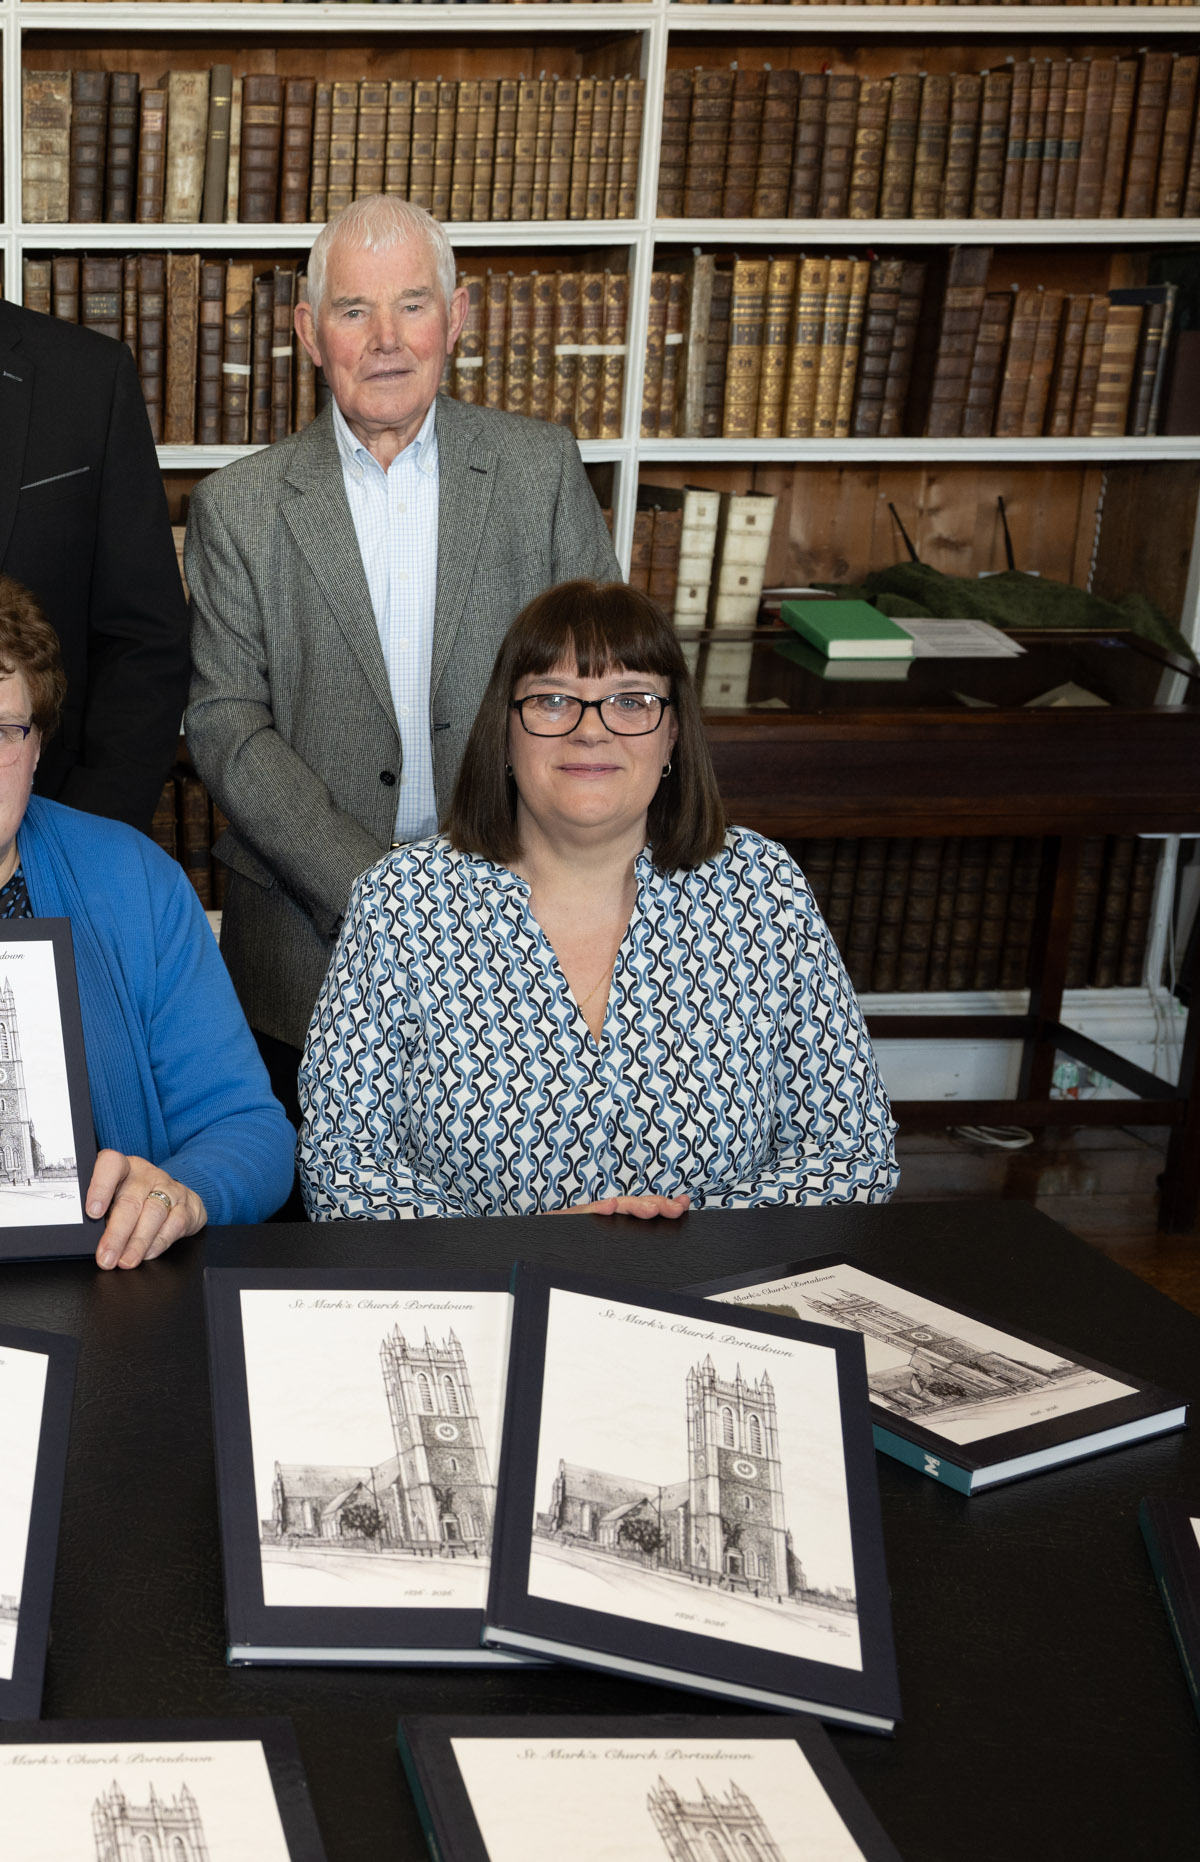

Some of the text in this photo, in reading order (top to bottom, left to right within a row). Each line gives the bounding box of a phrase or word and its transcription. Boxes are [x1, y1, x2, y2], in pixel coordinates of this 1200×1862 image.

[761, 1285, 791, 1296] Church
[791, 1274, 836, 1289] Portadown
[288, 1299, 475, 1311] St Mark's Church Portadown
[598, 1308, 795, 1358] St Mark's Church Portadown
[66, 1753, 120, 1765] Church
[517, 1748, 756, 1761] St Mark's Church Portadown
